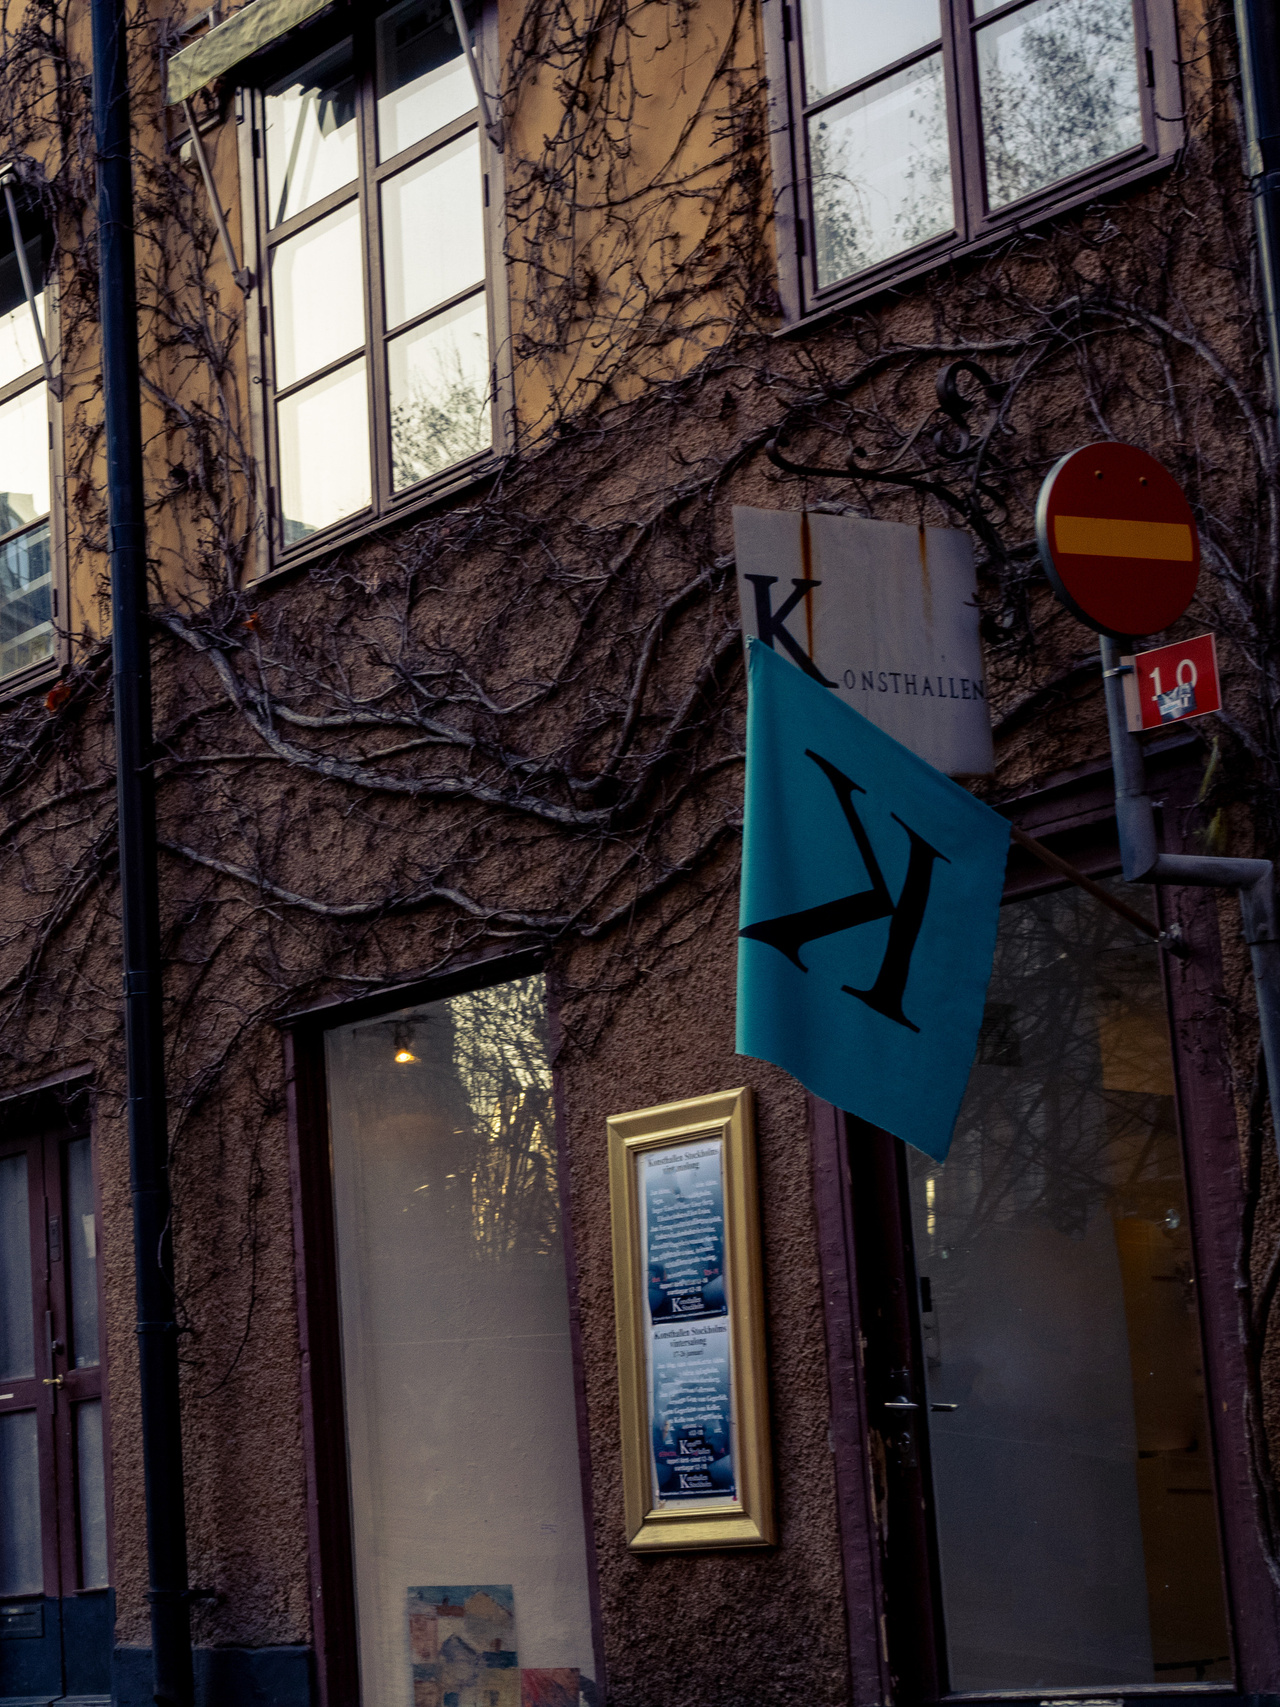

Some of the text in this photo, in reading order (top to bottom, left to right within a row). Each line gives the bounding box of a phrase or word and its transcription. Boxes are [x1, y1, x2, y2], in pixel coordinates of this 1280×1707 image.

[1148, 658, 1198, 702] 10
[654, 1325, 727, 1340] Konsthallen Stockholms
